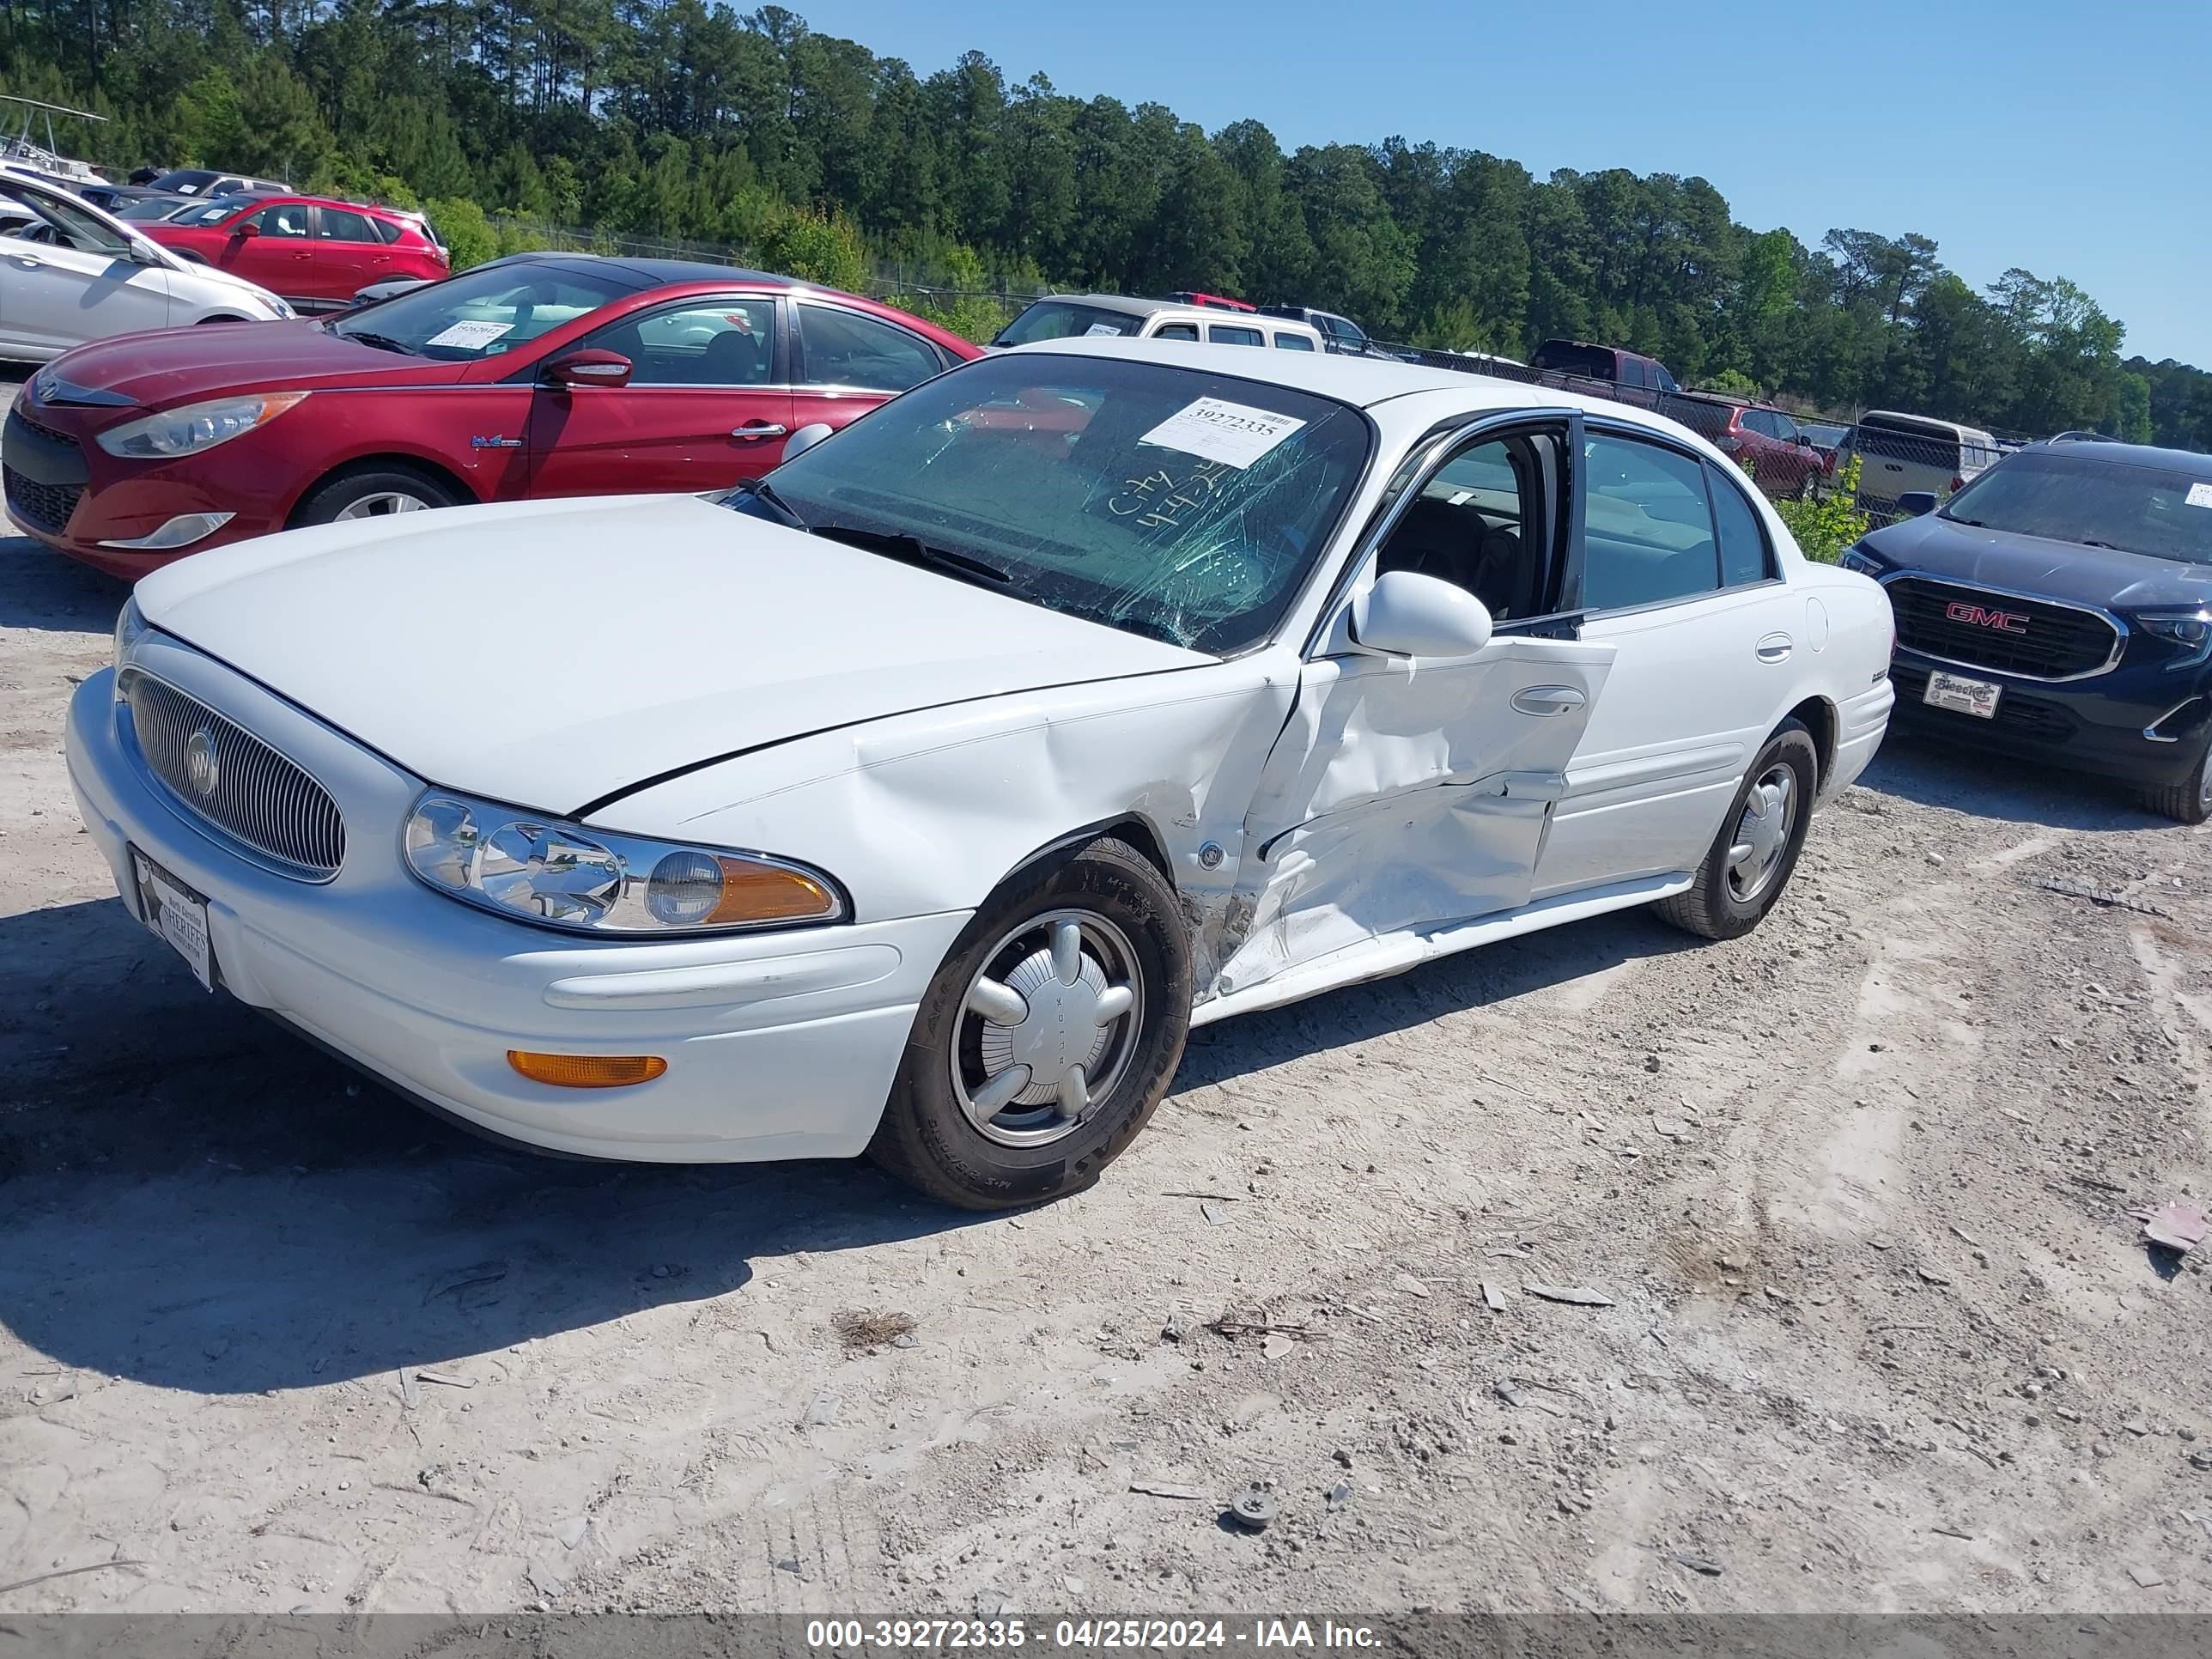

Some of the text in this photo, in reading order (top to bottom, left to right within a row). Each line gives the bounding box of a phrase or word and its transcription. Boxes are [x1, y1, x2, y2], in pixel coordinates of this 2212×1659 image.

[1189, 408, 1279, 435] 39272335
[1108, 471, 1174, 514] City
[1946, 602, 2030, 634] GMC
[163, 903, 206, 951] SHERIFFS
[169, 895, 202, 928] North Carolina
